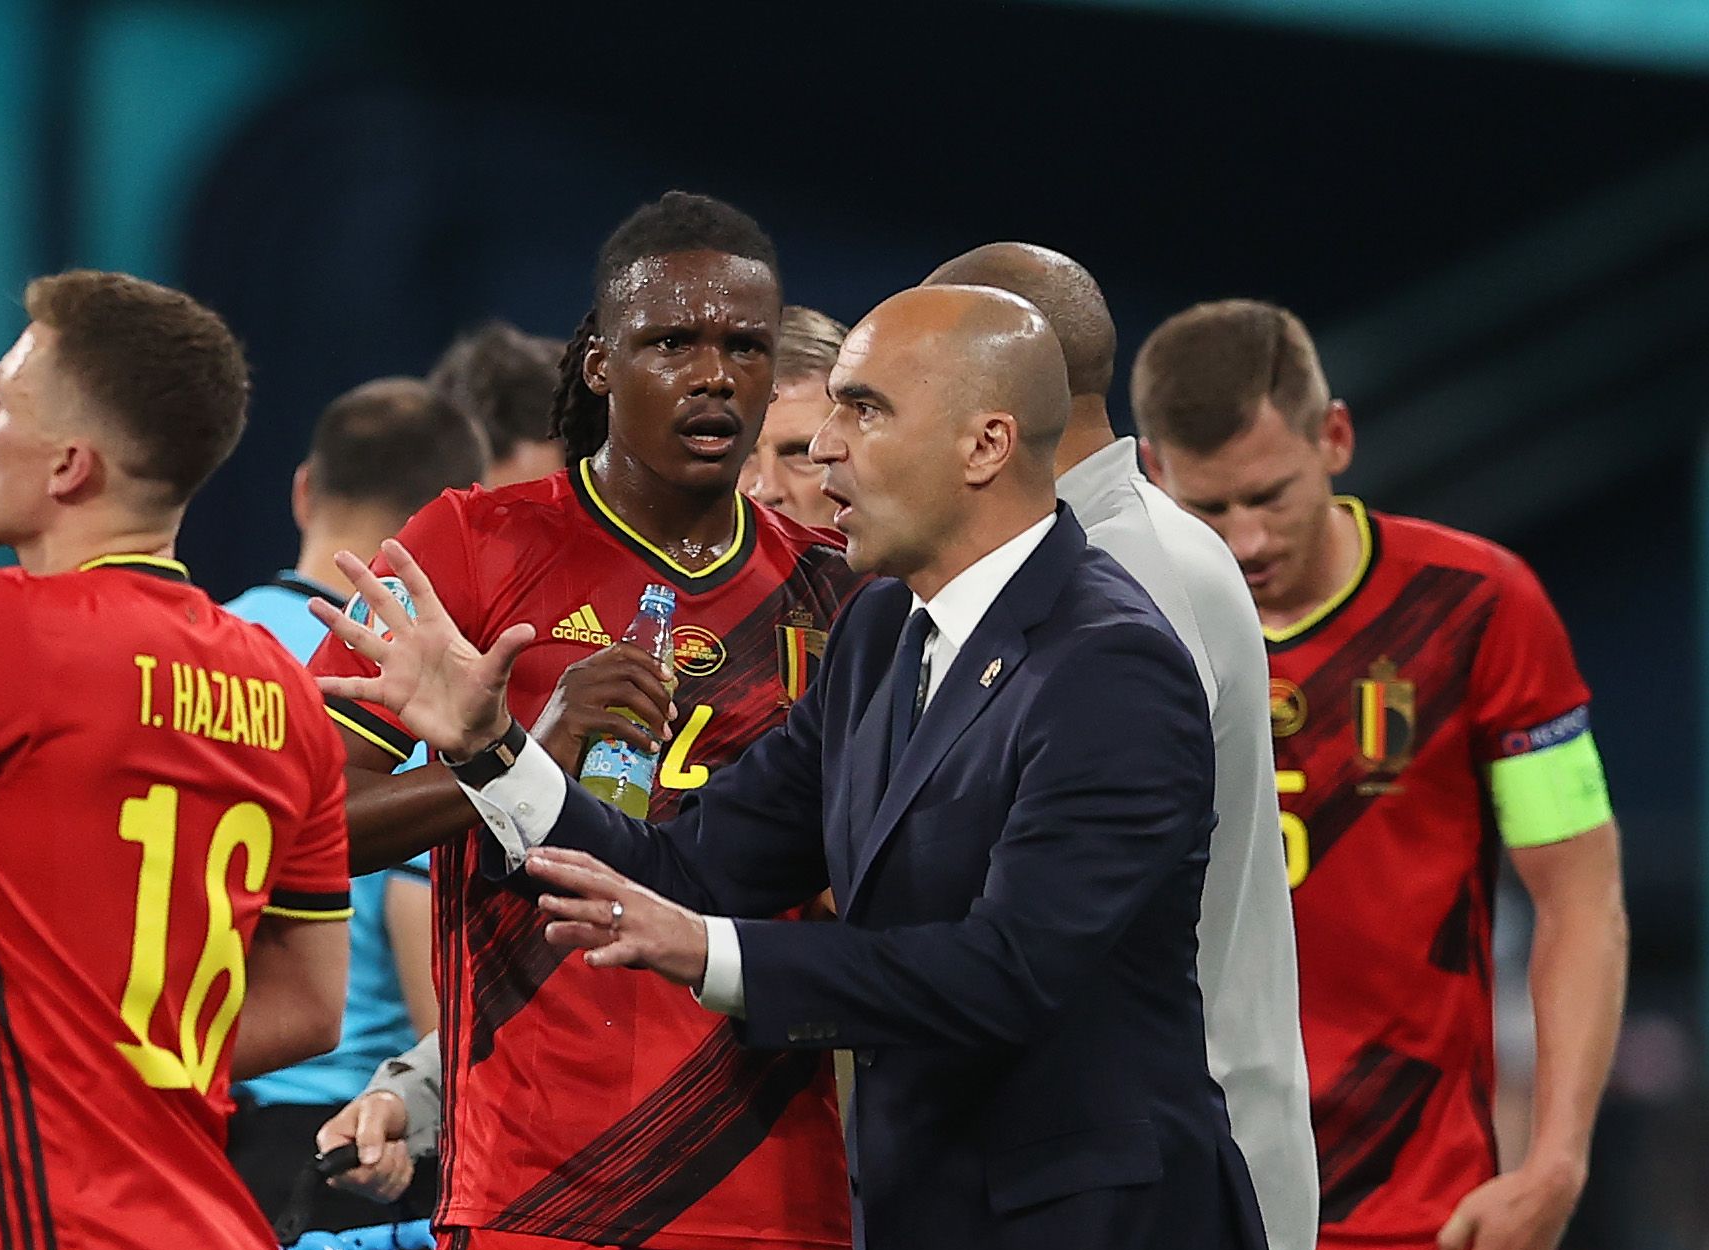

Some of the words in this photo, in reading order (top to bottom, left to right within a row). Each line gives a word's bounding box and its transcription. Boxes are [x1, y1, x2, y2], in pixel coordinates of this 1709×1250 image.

[551, 626, 612, 647] adidas
[134, 655, 164, 729] T.
[171, 661, 286, 751] HAZARD
[115, 783, 273, 1096] 16
